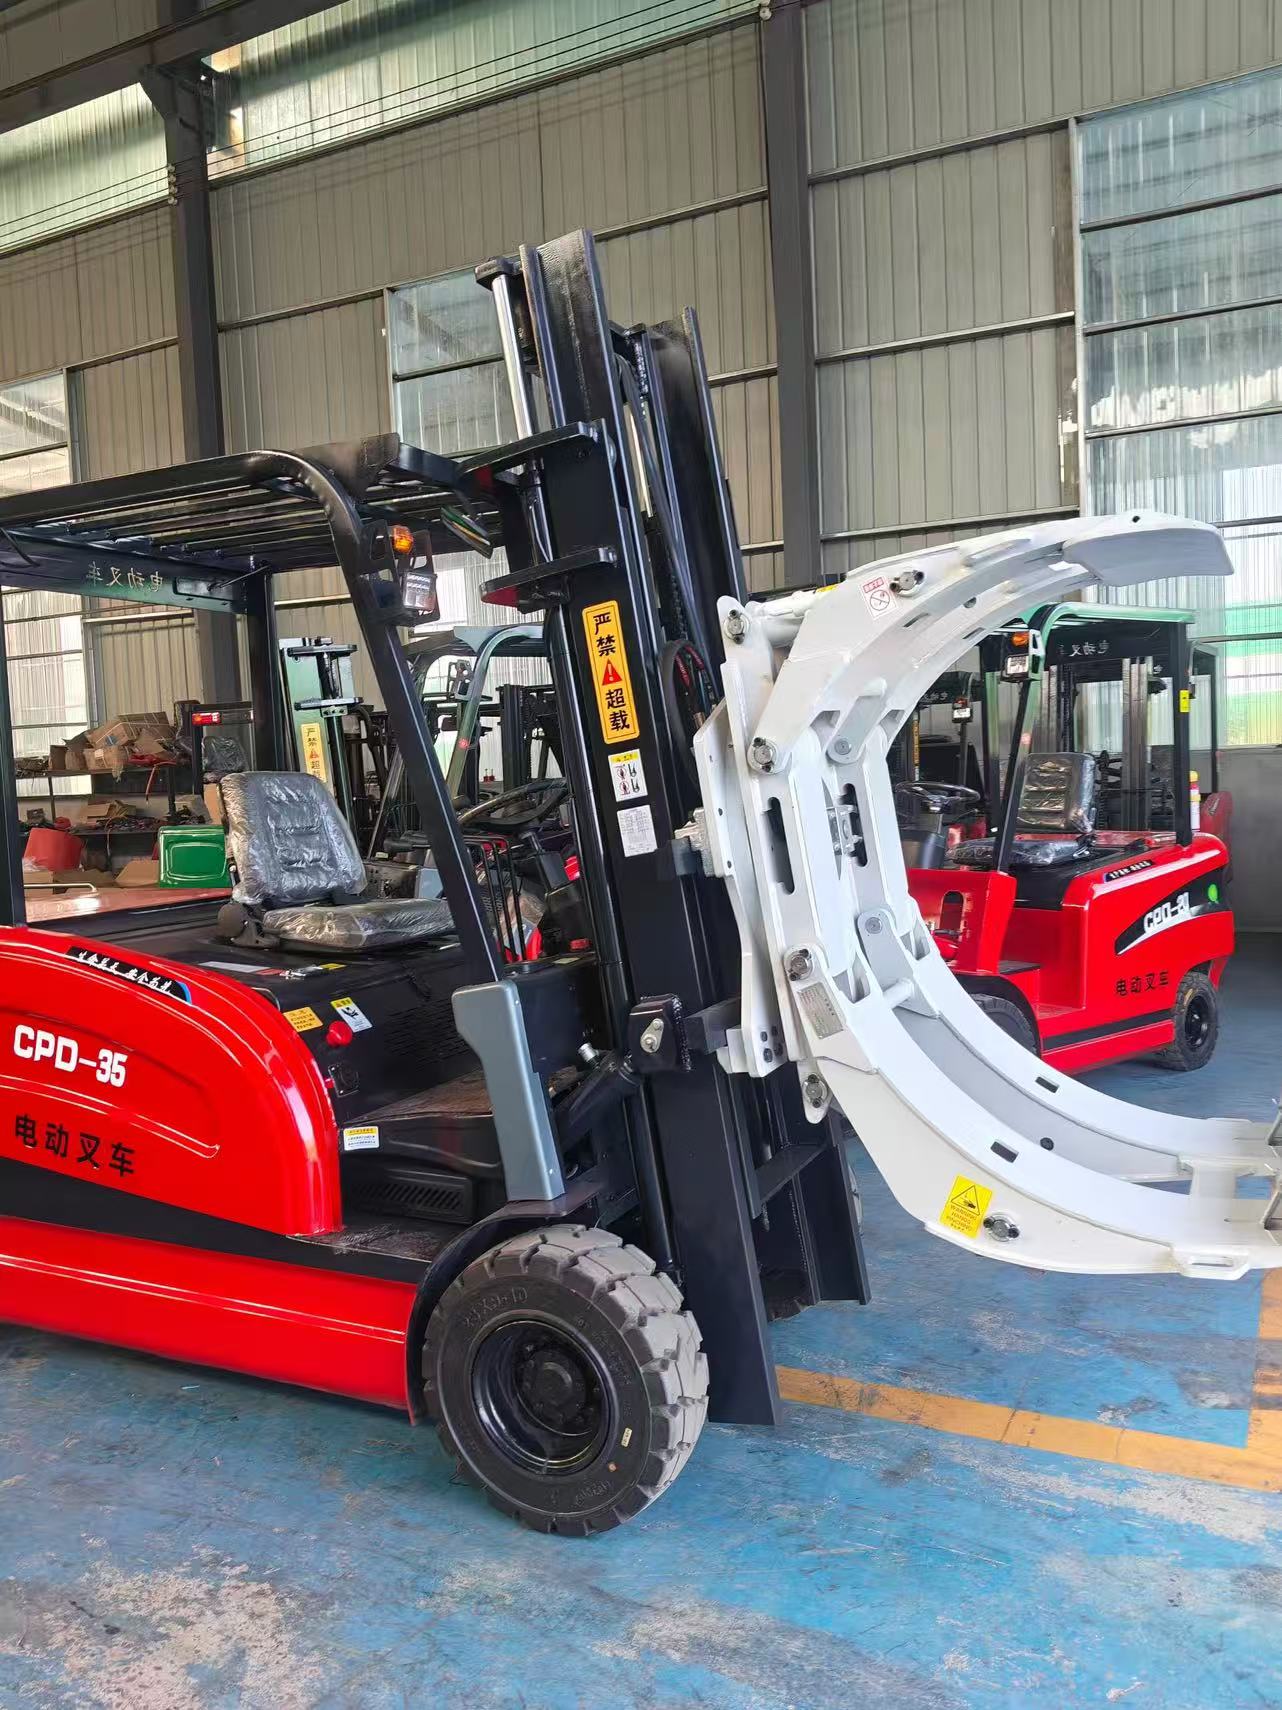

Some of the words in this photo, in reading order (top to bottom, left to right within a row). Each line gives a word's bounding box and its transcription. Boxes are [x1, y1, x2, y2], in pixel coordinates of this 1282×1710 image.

[13, 1024, 128, 1088] CPD-35
[15, 1113, 135, 1177] 电动叉车
